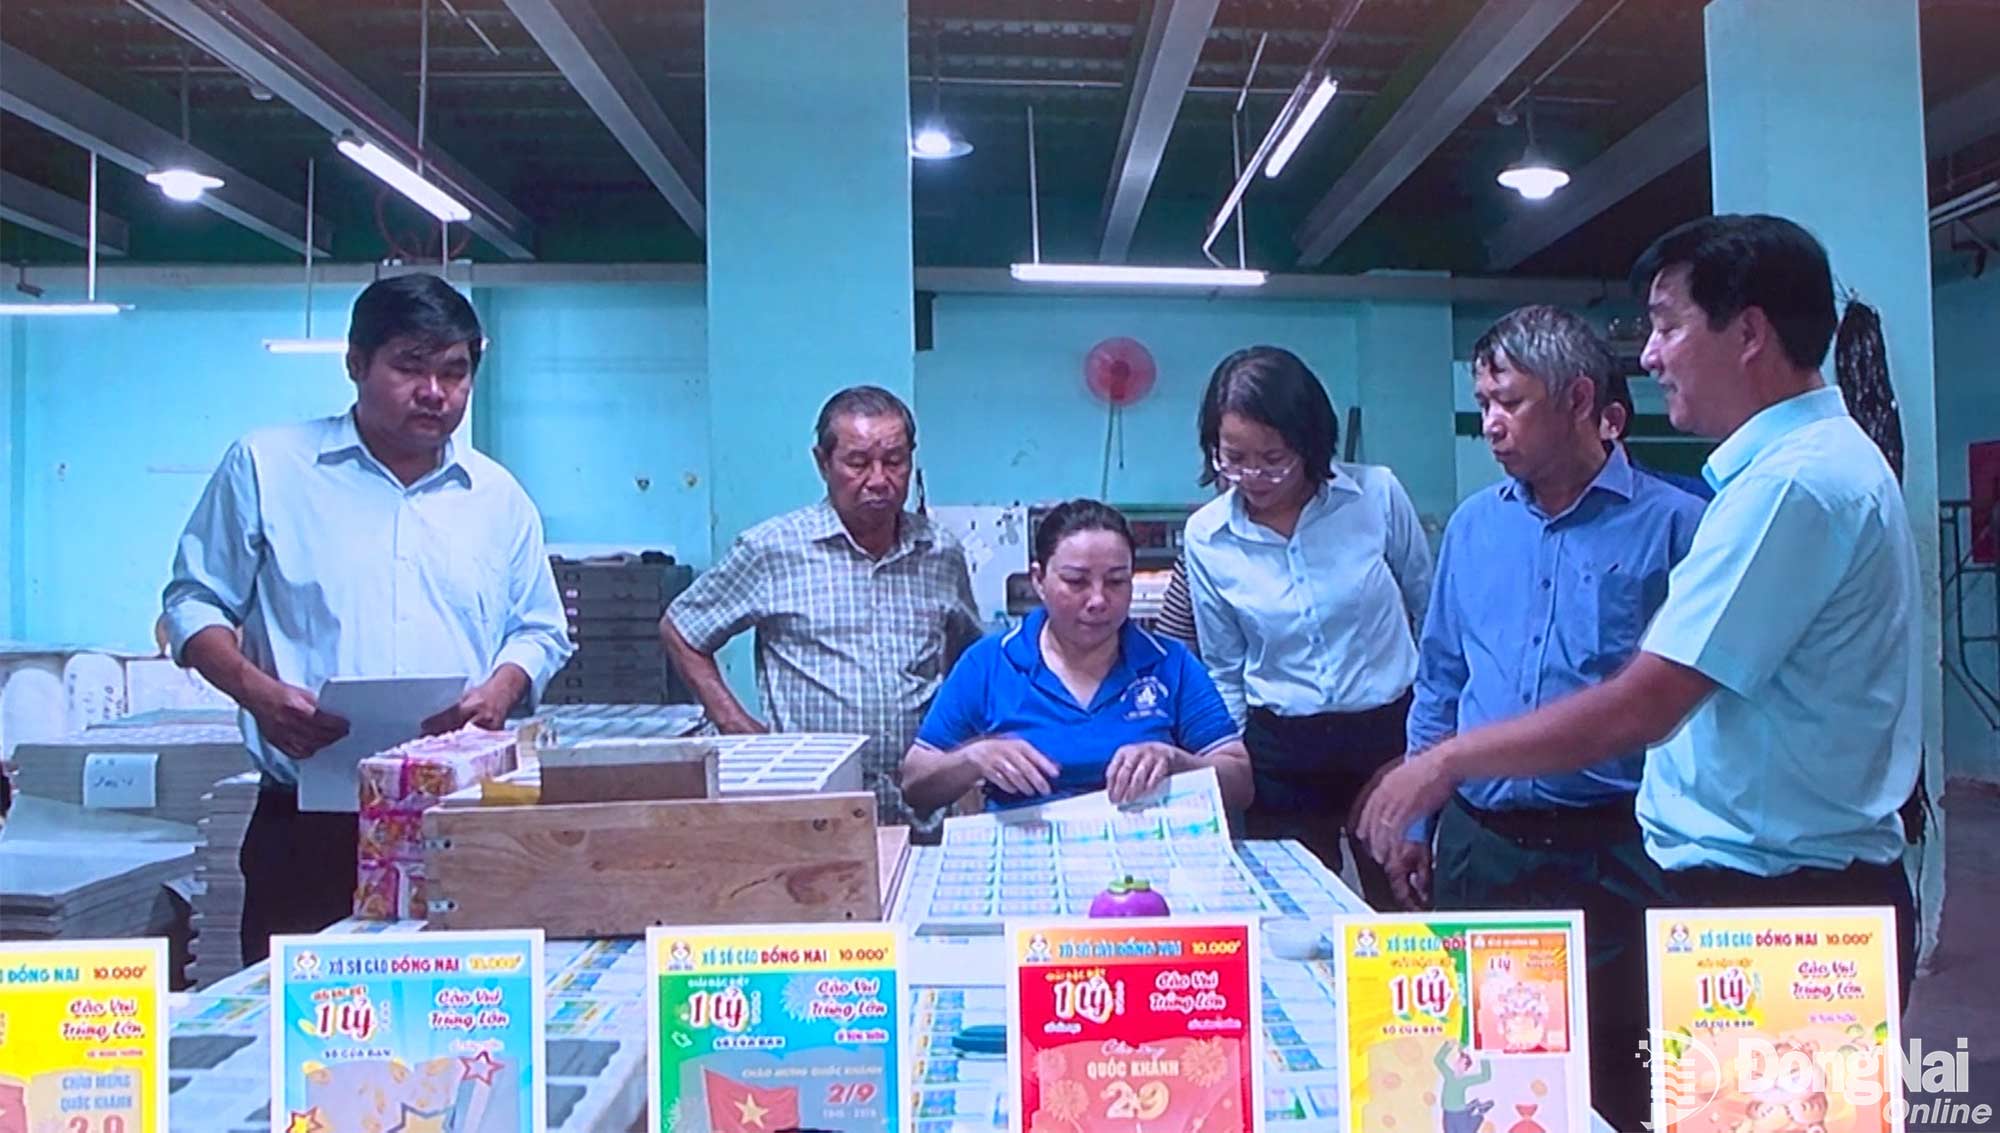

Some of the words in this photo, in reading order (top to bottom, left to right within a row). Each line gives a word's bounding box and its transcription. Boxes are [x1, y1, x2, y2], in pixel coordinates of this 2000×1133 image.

[1795, 933, 1818, 946] NAI
[434, 957, 460, 972] NAI
[804, 949, 828, 963] NAI
[54, 966, 80, 982] NAI
[1415, 967, 1447, 1014] tỷ
[1719, 967, 1746, 1009] tỷ
[340, 998, 373, 1039] tỷ
[713, 986, 745, 1030] tỷ
[826, 1082, 877, 1104] 2/9
